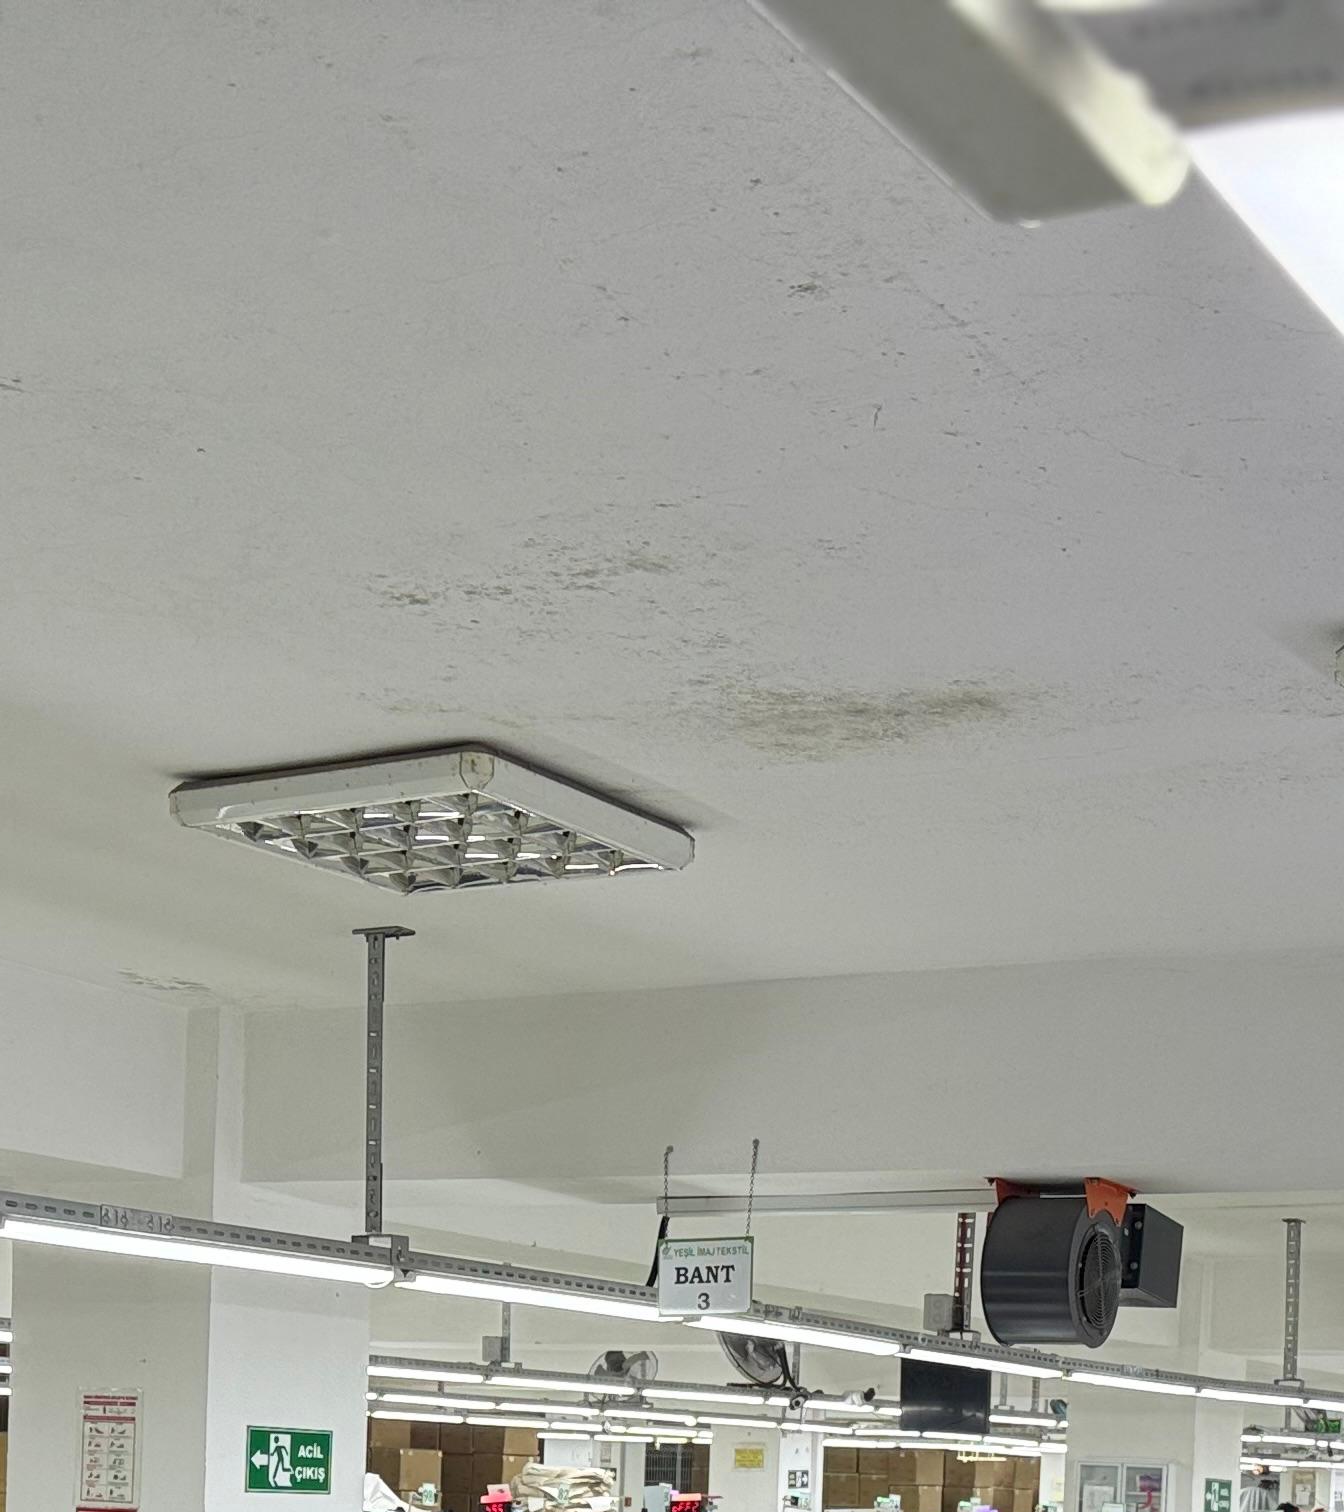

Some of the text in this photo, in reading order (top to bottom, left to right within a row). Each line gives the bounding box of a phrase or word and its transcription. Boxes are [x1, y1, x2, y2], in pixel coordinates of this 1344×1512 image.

[674, 1264, 736, 1285] BANT
[697, 1292, 711, 1311] 3
[297, 1442, 324, 1459] ACİL
[294, 1466, 326, 1484] ÇIKIŞ
